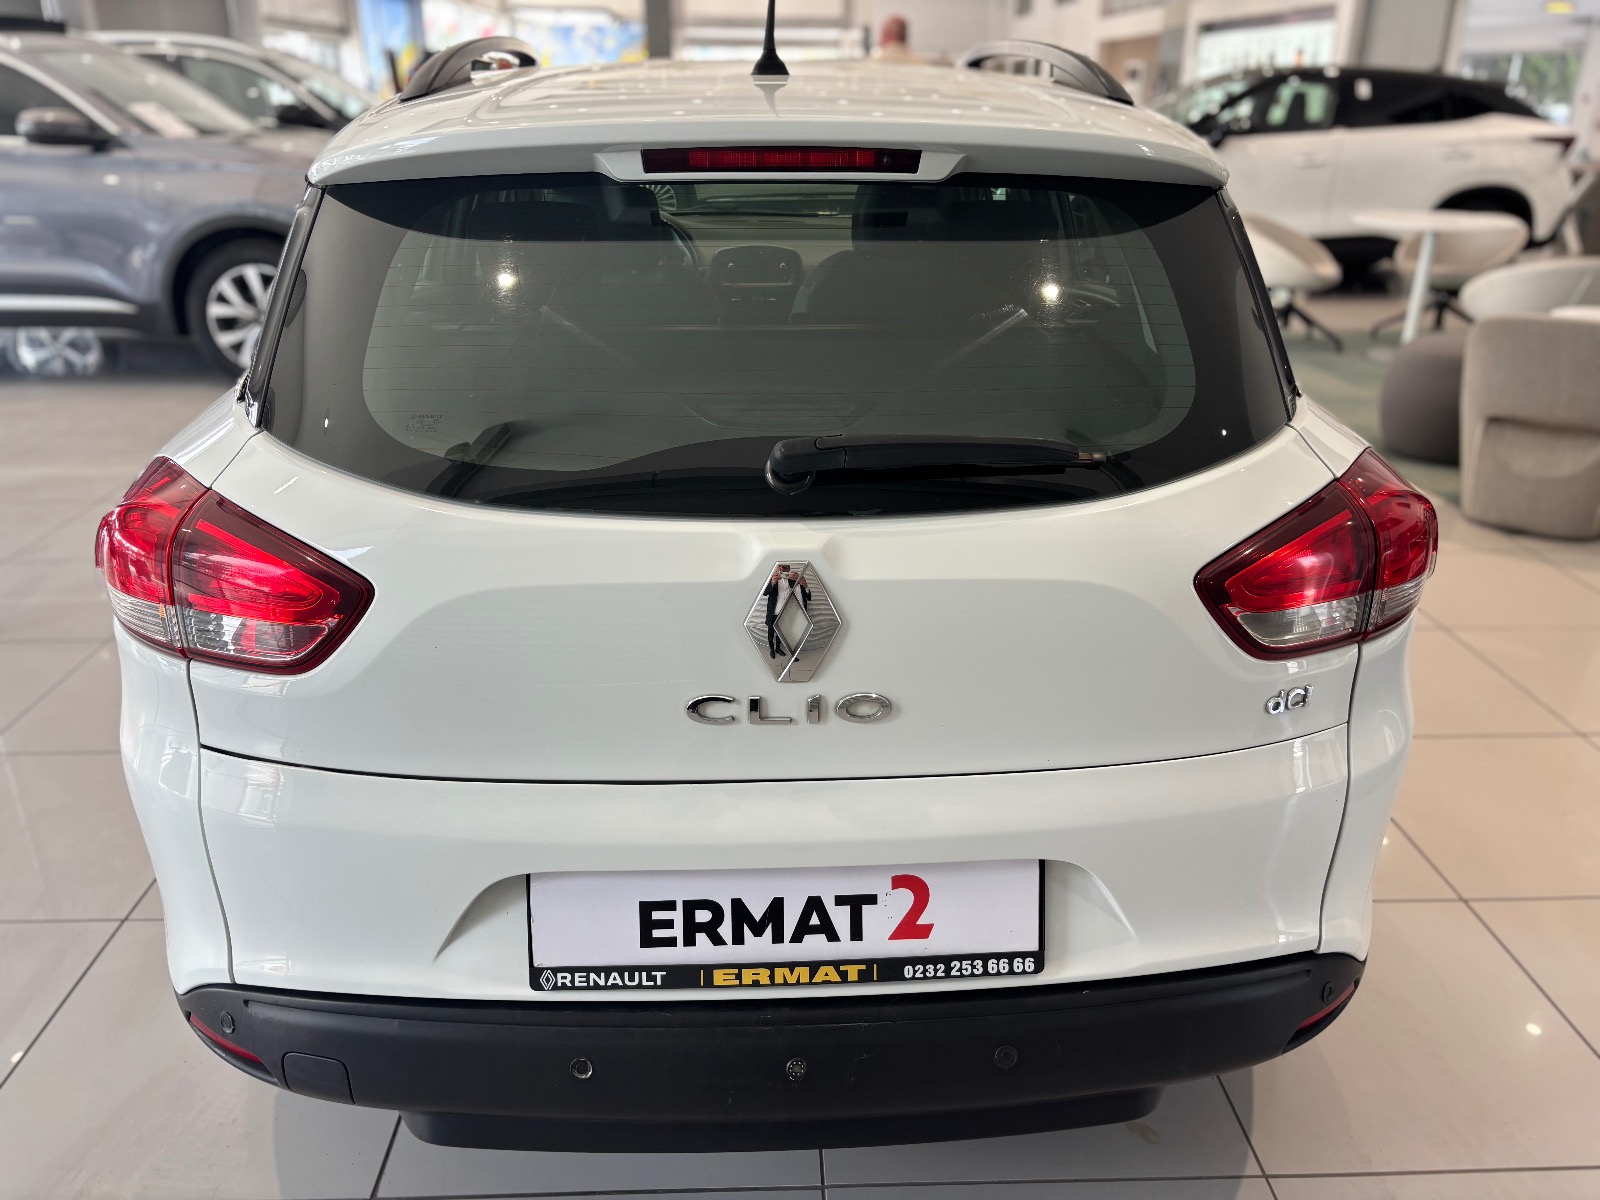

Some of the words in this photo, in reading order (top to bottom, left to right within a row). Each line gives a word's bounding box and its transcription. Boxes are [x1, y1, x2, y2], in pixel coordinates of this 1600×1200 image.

[686, 692, 892, 725] CLIO
[639, 893, 878, 949] ERMAT
[888, 874, 934, 941] 2
[713, 964, 867, 986] ERMAT
[903, 963, 945, 978] 0232
[950, 959, 983, 976] 253
[987, 958, 1009, 974] 66
[1013, 957, 1035, 973] 66
[556, 971, 667, 987] RENAULT
